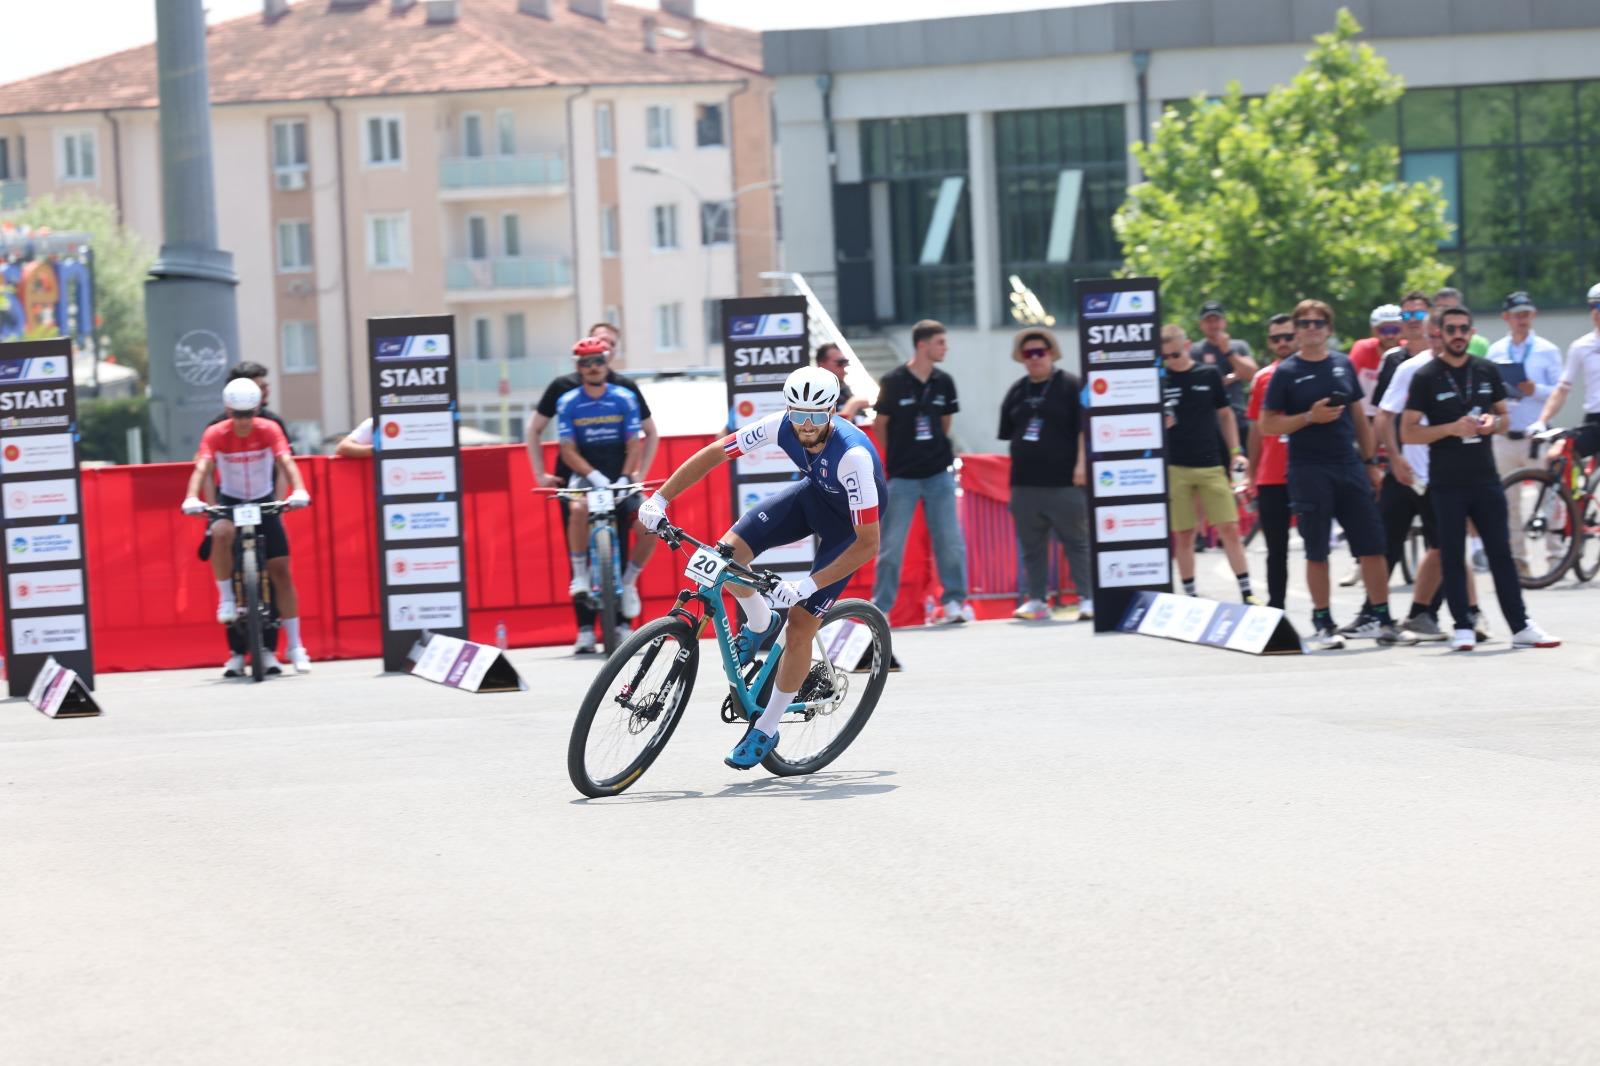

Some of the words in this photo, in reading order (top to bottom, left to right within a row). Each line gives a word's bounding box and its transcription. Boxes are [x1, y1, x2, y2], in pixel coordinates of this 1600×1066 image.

[1088, 323, 1154, 345] START
[734, 345, 803, 367] START
[380, 366, 448, 388] START
[0, 388, 67, 411] START
[745, 426, 764, 445] CIC
[846, 477, 859, 502] CIC
[693, 554, 718, 575] 20
